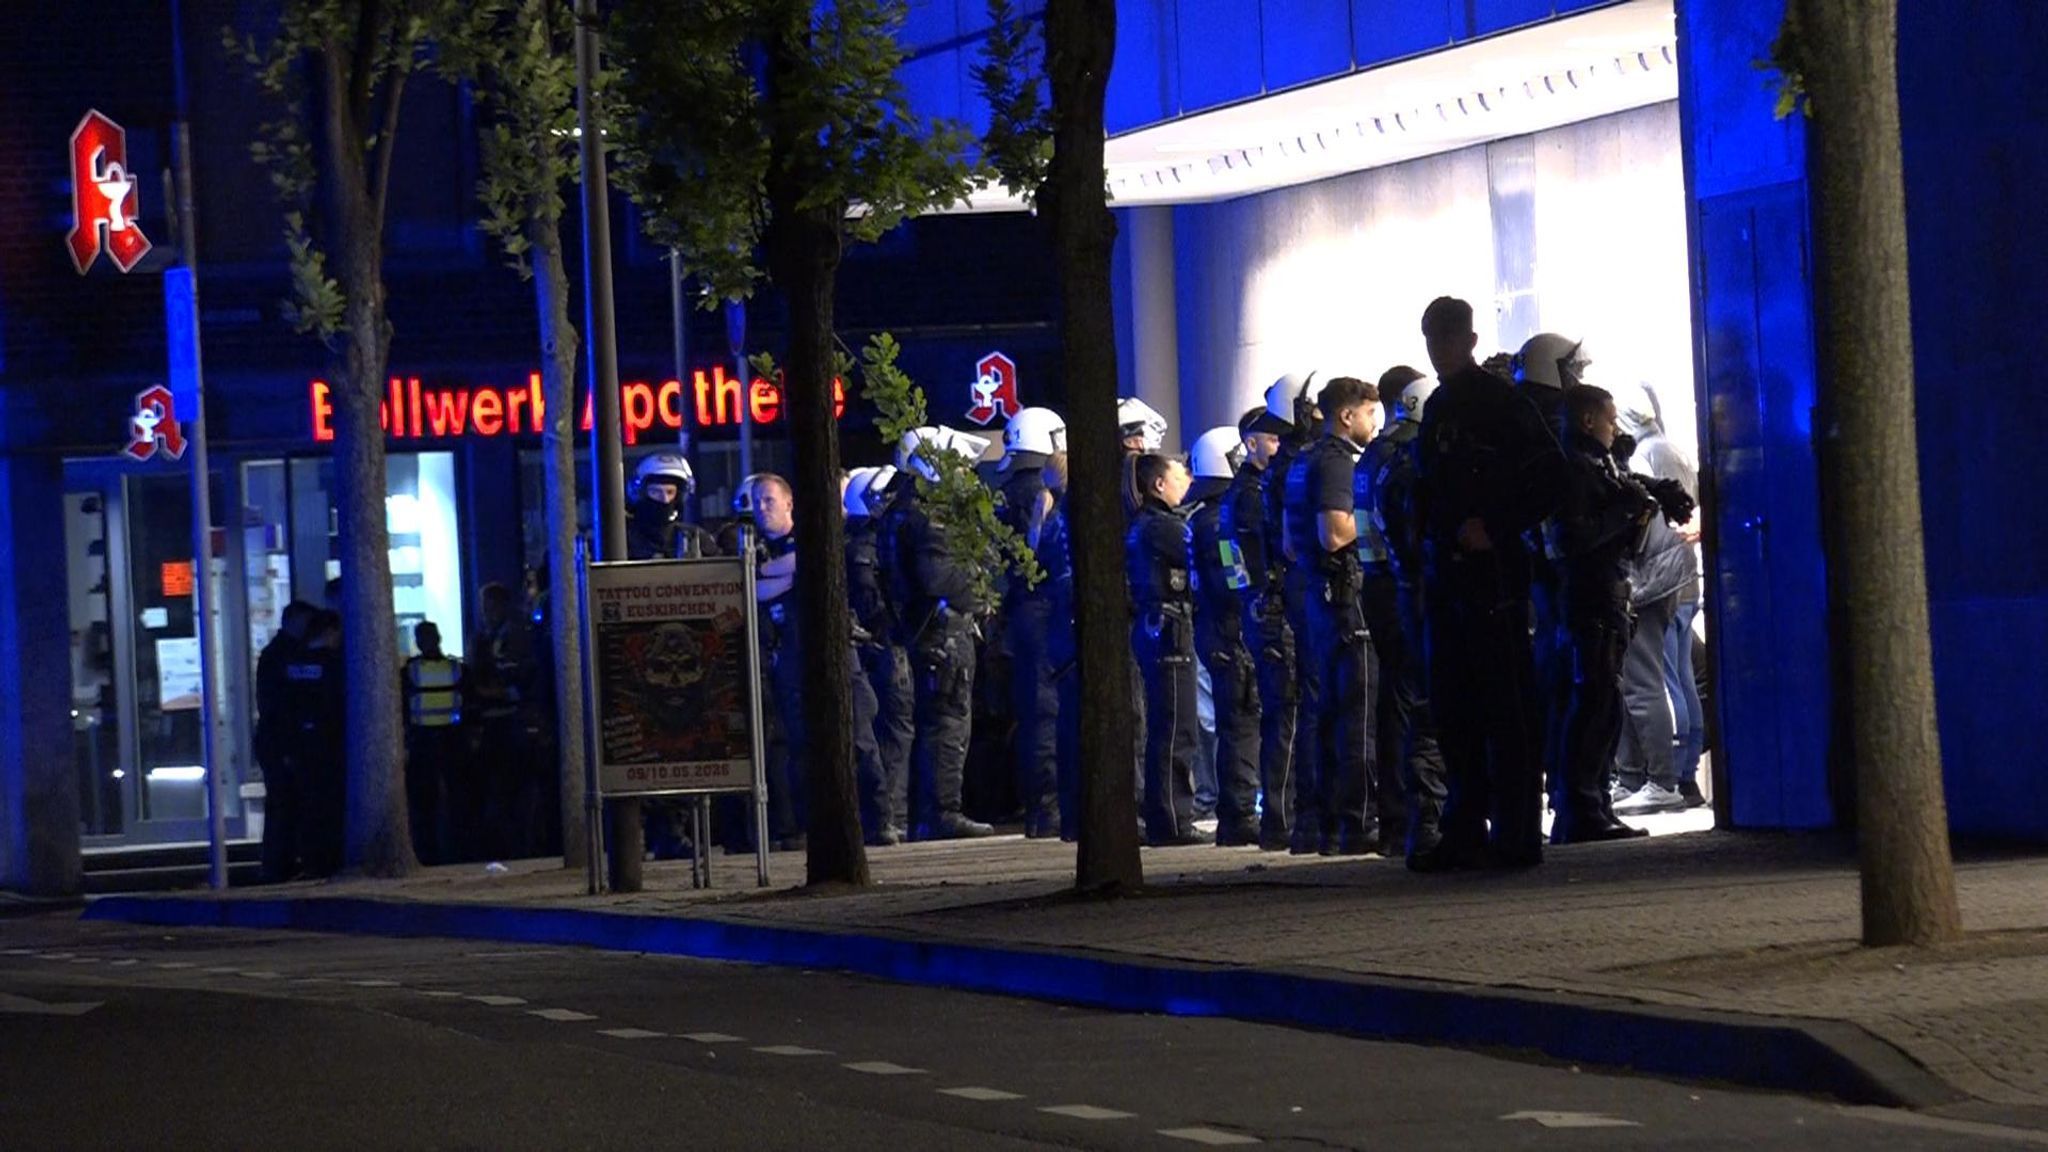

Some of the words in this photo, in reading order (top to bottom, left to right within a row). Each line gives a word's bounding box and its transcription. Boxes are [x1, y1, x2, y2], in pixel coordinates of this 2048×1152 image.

[311, 372, 546, 441] Bllwer
[581, 366, 846, 445] pothe
[597, 586, 651, 600] TATTOO
[655, 582, 743, 598] CONVENTION
[627, 602, 716, 617] EUSKIRCHEN
